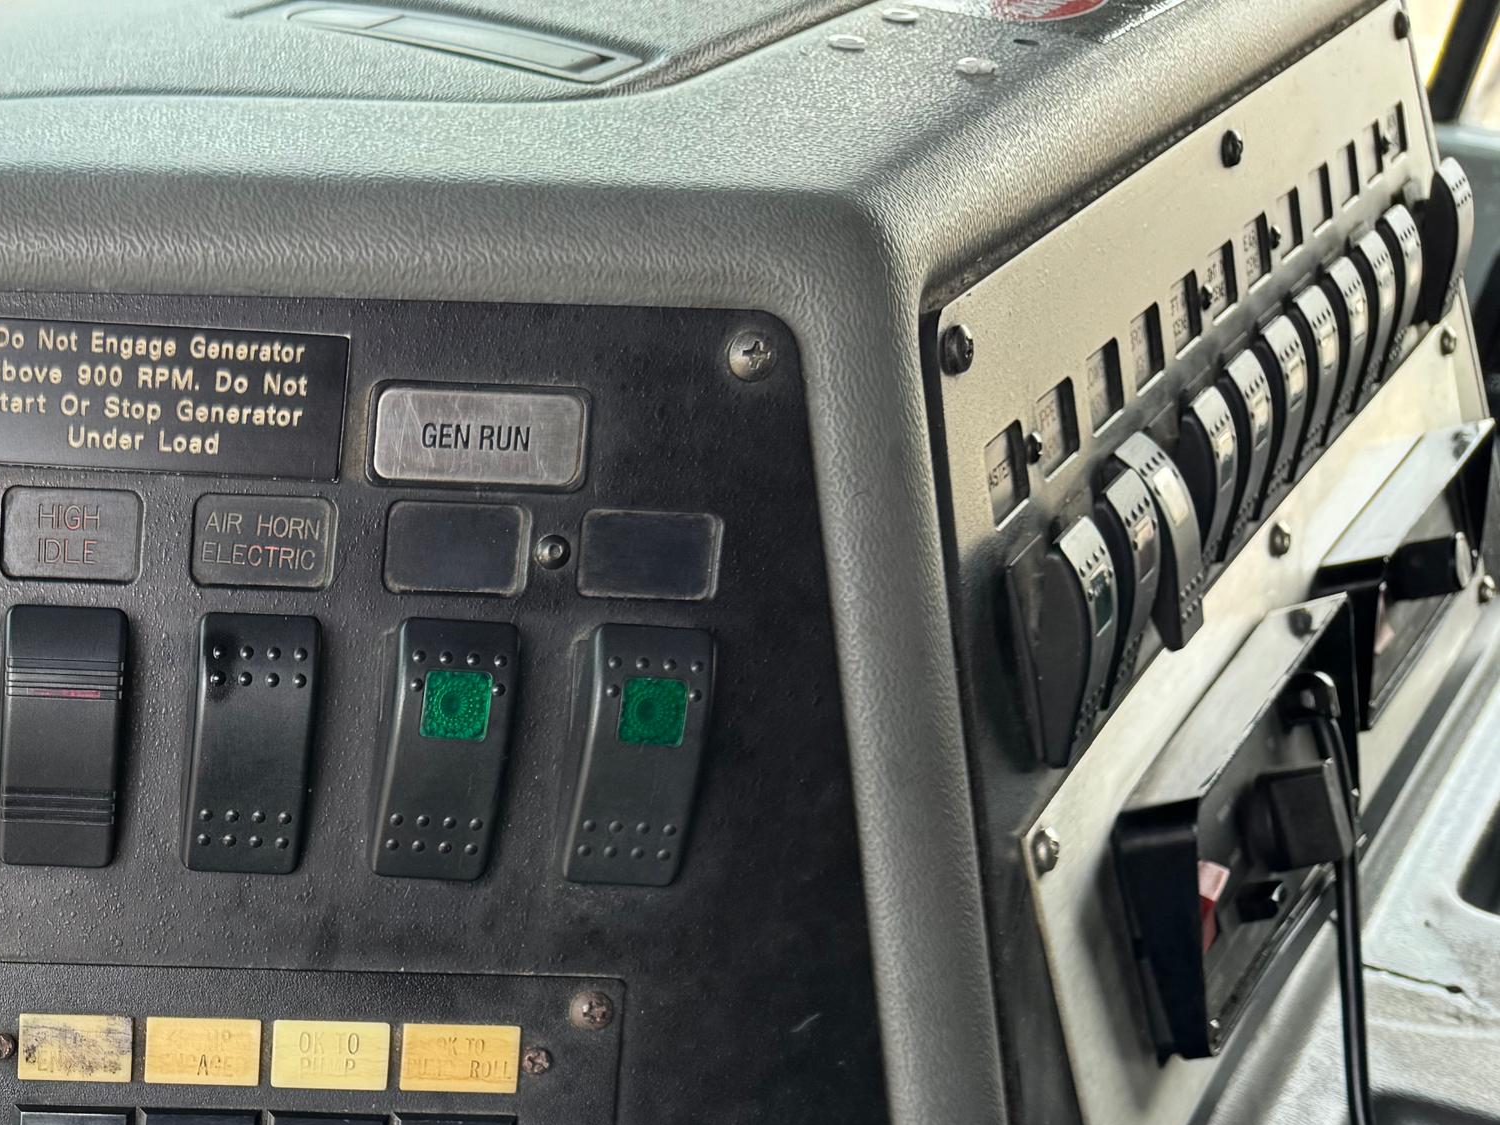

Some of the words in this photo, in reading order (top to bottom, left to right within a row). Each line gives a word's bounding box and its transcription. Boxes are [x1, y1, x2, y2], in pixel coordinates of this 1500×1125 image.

[37, 328, 78, 353] Not
[91, 332, 176, 361] Engage
[190, 337, 305, 363] Generator
[77, 365, 122, 387] 900
[137, 366, 200, 391] RPM.
[215, 371, 248, 394] Do
[264, 373, 308, 397] Not
[60, 393, 90, 416] Or
[103, 394, 161, 423] Stop
[176, 400, 302, 427] Generator
[68, 425, 144, 450] Under
[158, 430, 220, 455] Load
[421, 422, 471, 450] GEN
[478, 425, 531, 452] RUN
[37, 504, 100, 530] HIGH
[204, 511, 243, 535] AIR
[256, 514, 320, 541] HORN
[37, 538, 98, 565] IDLE
[201, 542, 316, 571] ELECTRIC
[299, 1031, 325, 1055] OK
[336, 1032, 360, 1055] TO
[465, 1038, 486, 1057] TO
[469, 1060, 512, 1081] ROLL
